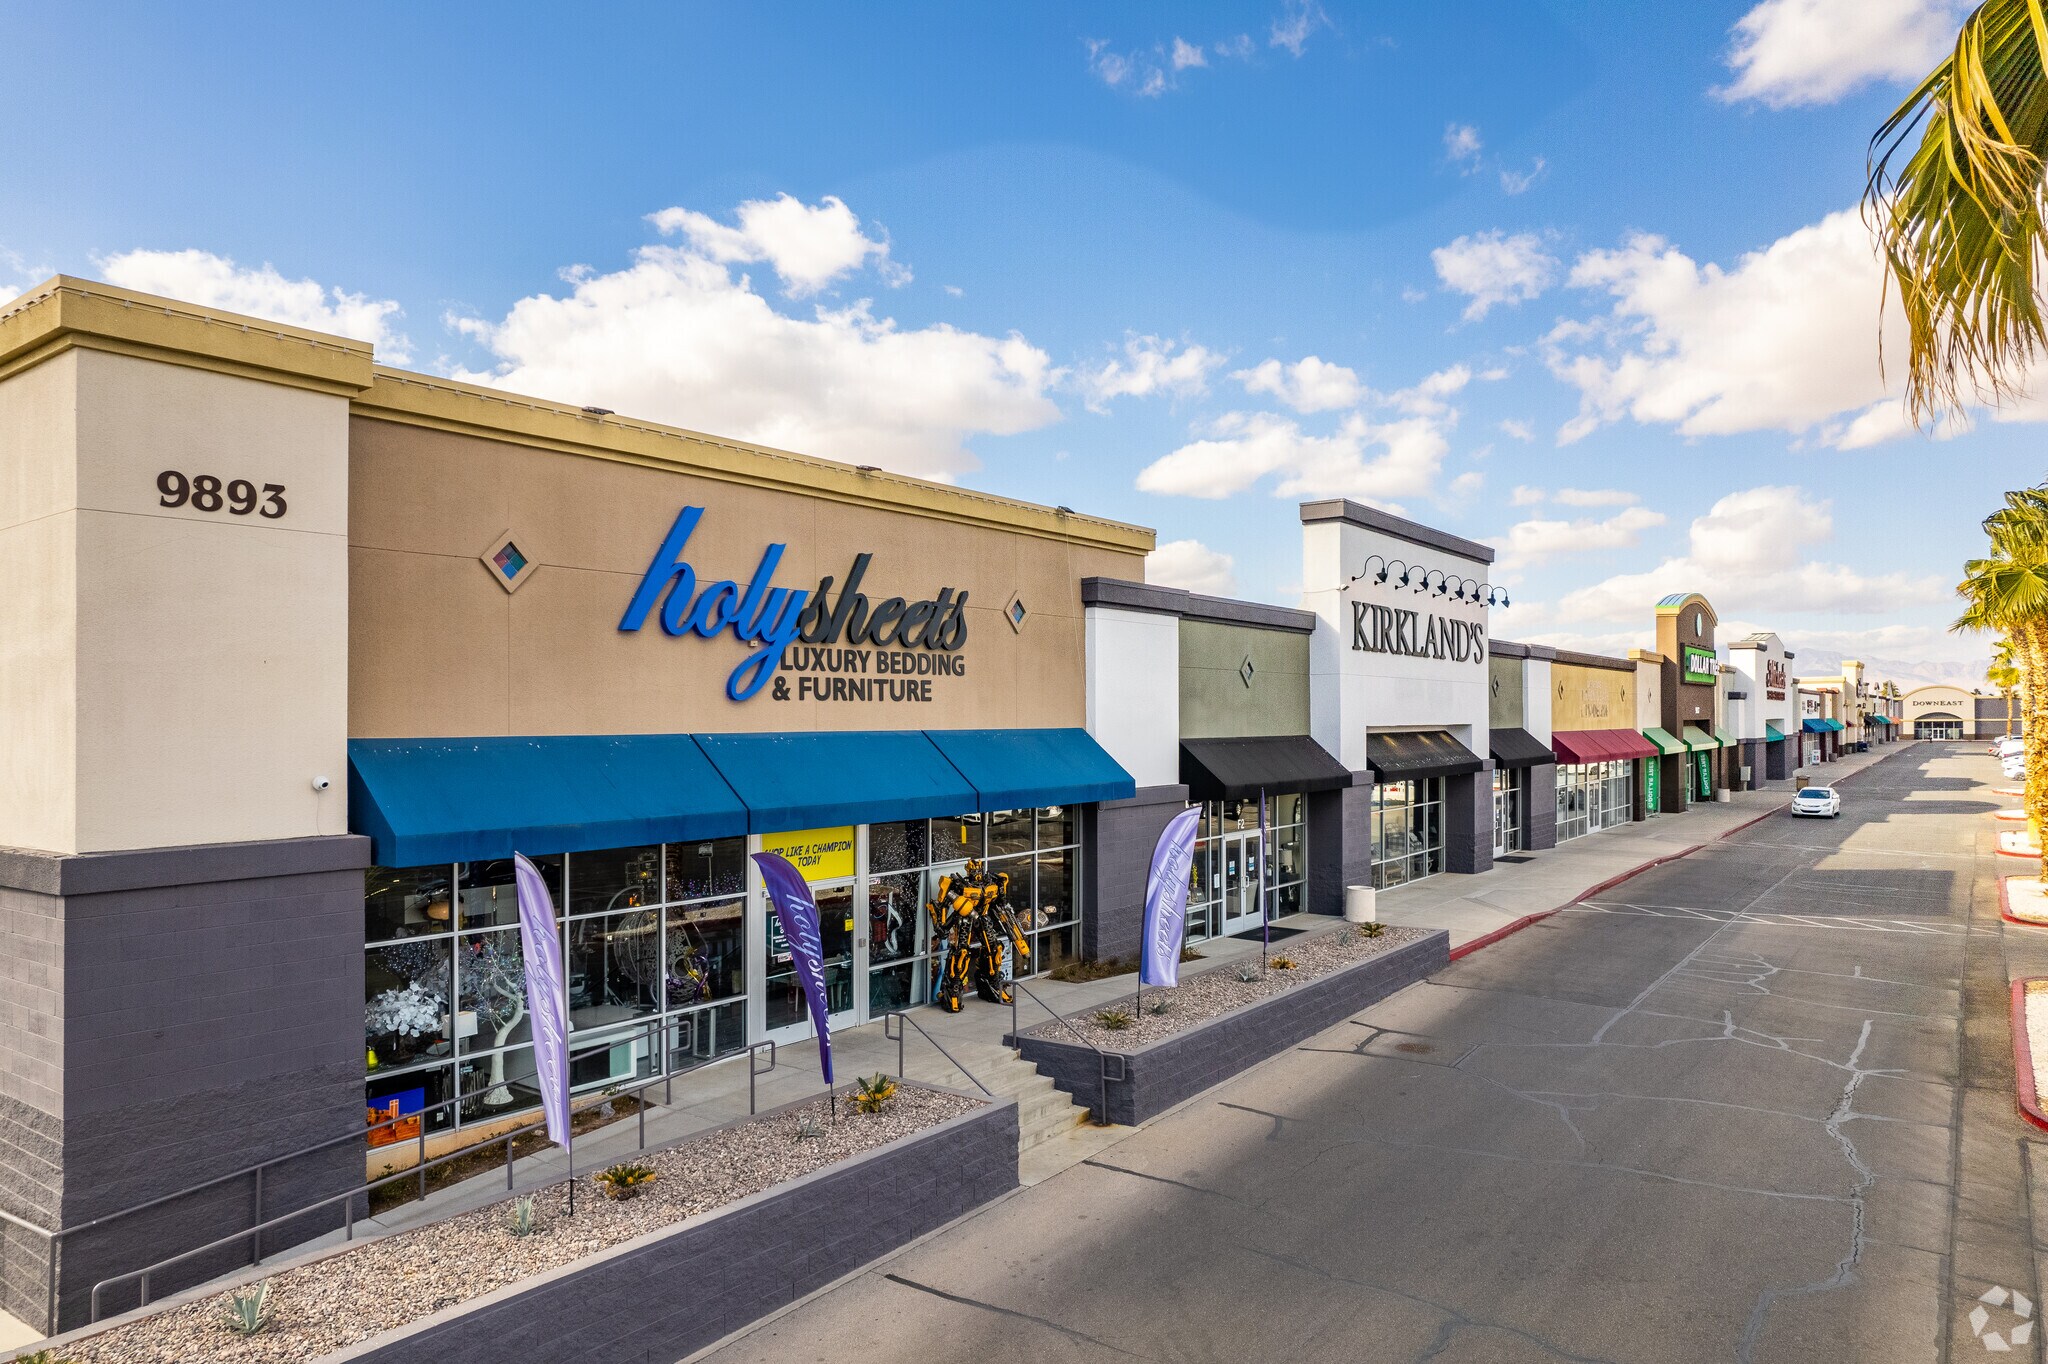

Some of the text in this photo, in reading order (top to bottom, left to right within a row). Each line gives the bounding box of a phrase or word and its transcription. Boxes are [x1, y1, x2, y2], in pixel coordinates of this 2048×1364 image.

[156, 470, 288, 519] 9893
[1351, 601, 1484, 665] KIRKLAND'S
[780, 647, 965, 677] LUXURY BEDDING
[772, 676, 932, 702] & FURNITURE
[785, 845, 803, 857] LIKE
[804, 845, 810, 854] A
[812, 840, 852, 854] CHAMPION
[798, 855, 822, 867] TODAY
